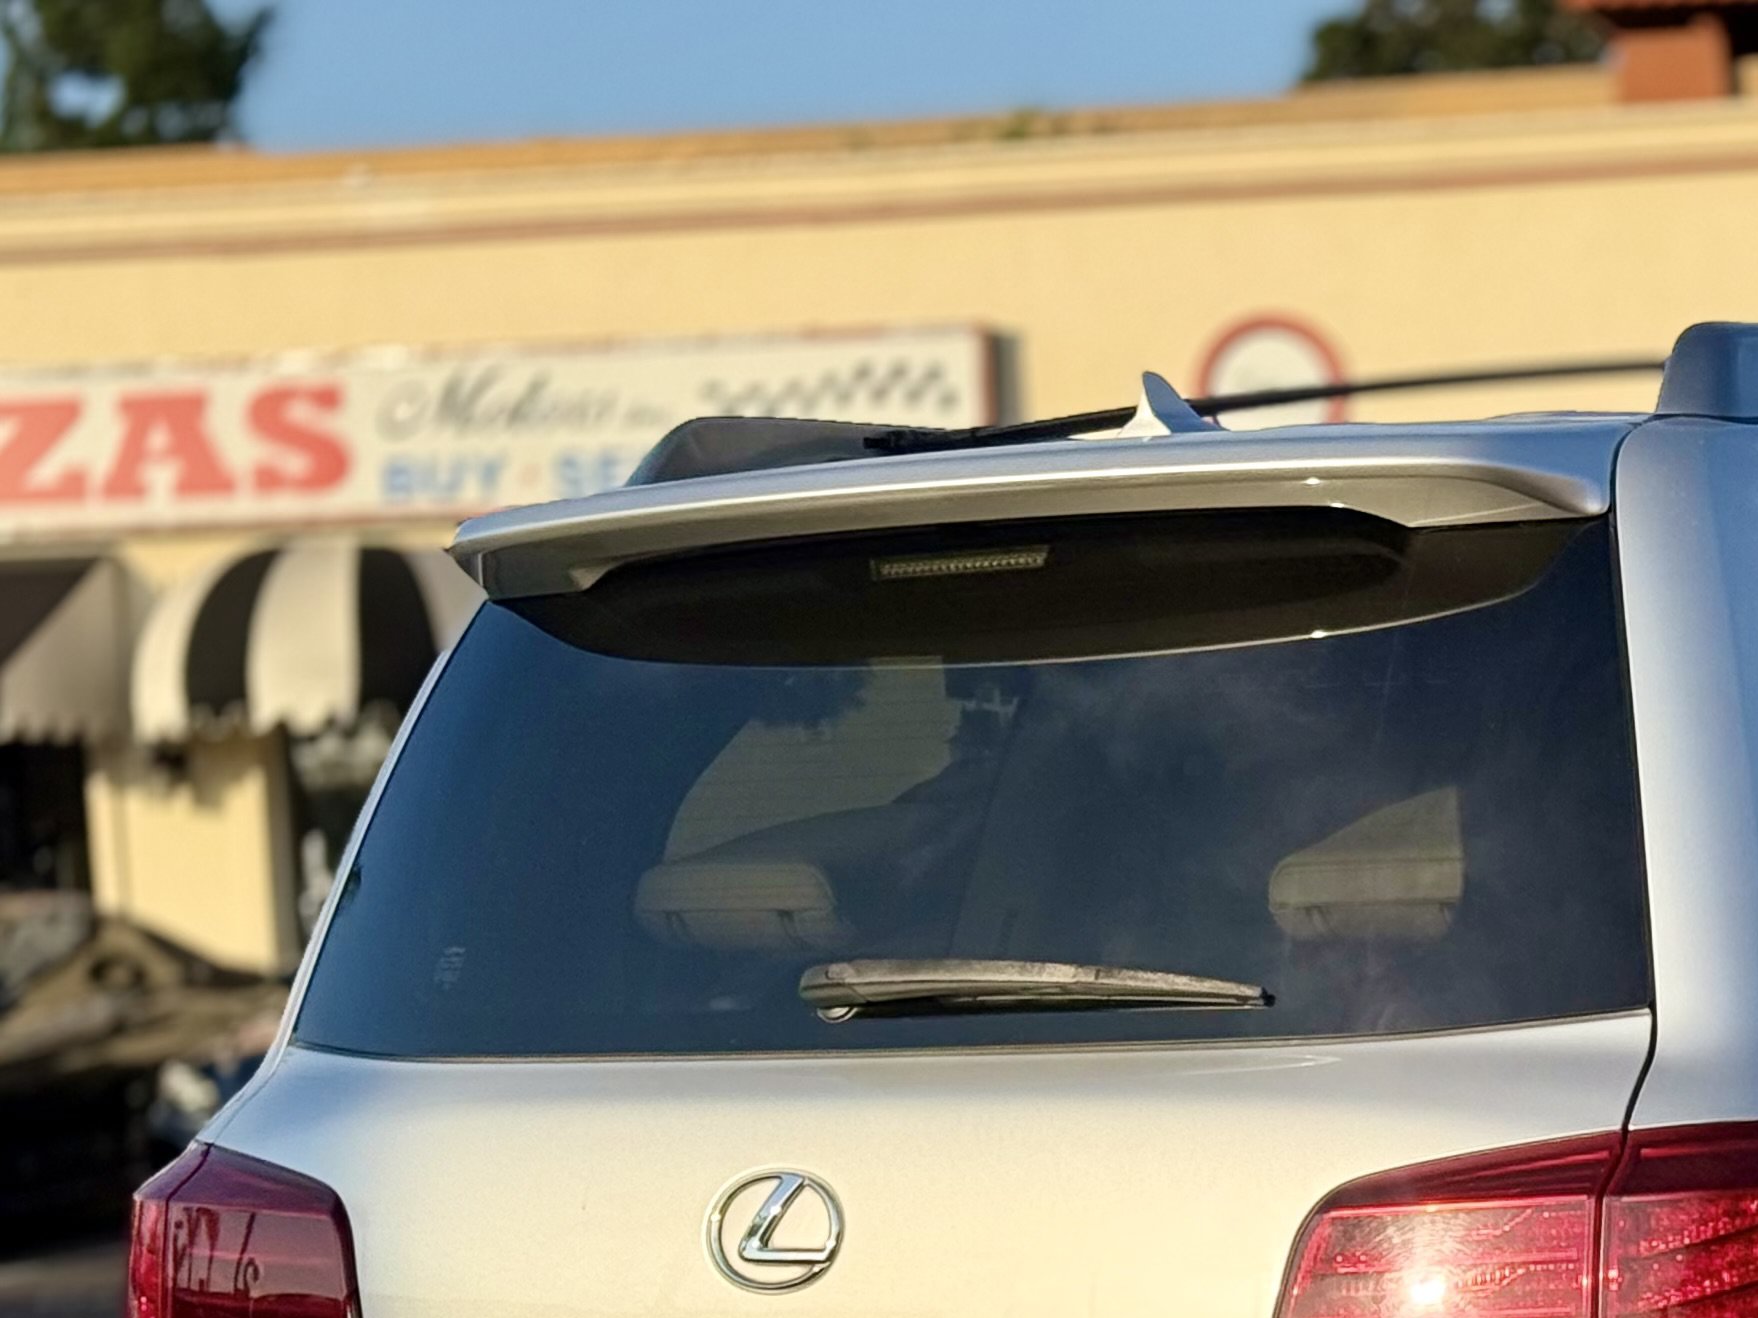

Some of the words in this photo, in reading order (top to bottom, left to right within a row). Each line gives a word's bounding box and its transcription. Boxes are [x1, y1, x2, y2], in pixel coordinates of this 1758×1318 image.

[0, 386, 352, 503] ZAS
[382, 452, 502, 502] BUY
[553, 447, 640, 498] SE
